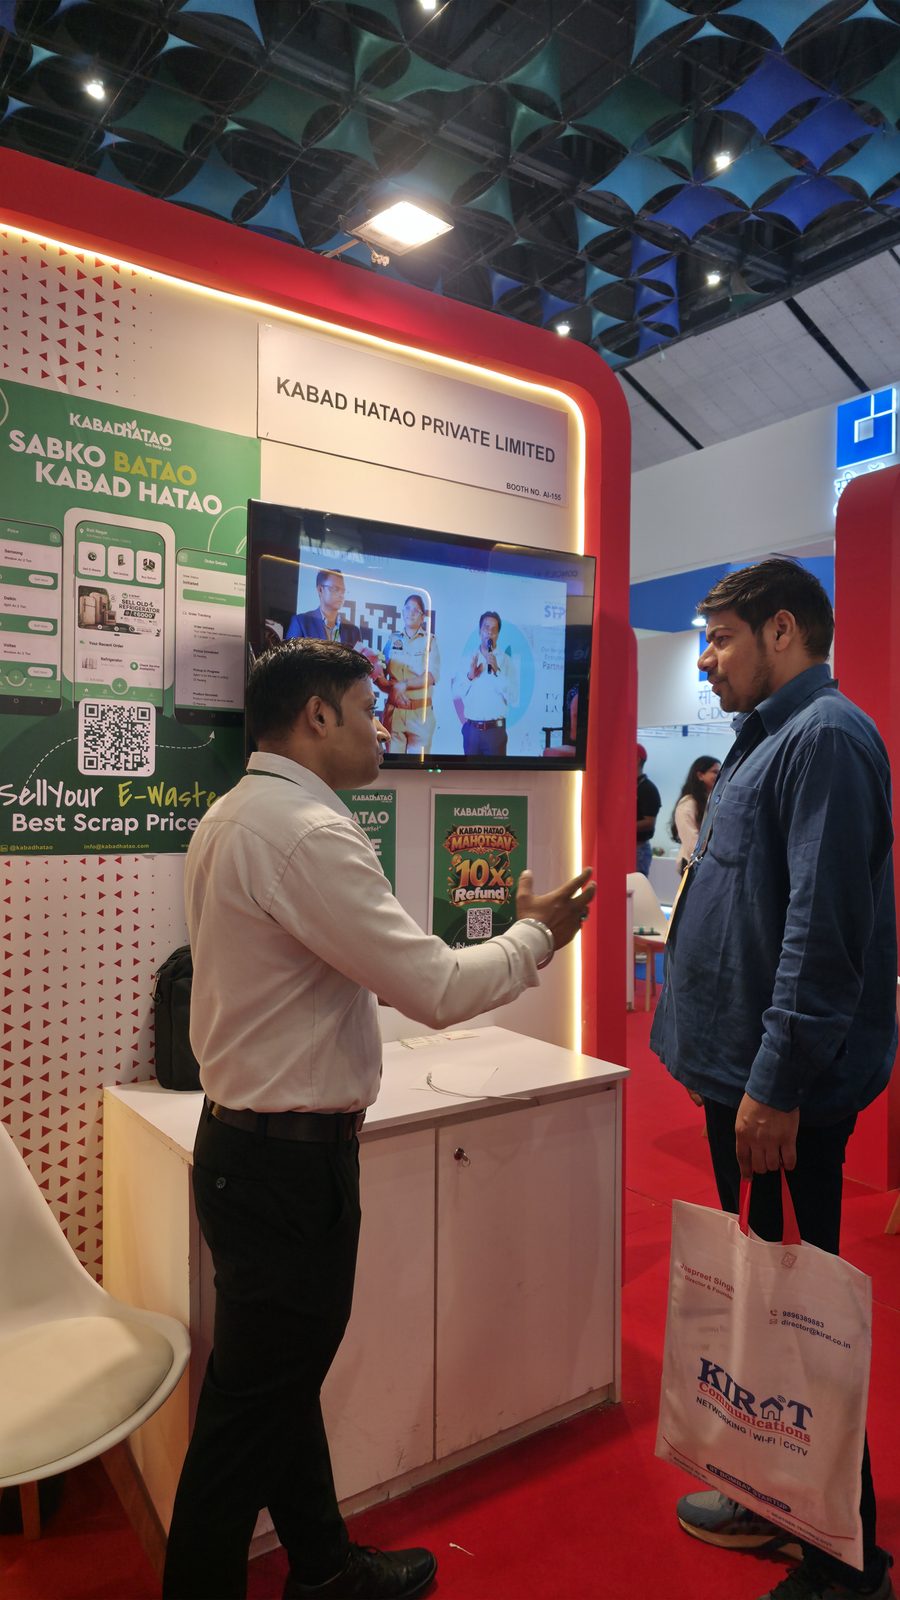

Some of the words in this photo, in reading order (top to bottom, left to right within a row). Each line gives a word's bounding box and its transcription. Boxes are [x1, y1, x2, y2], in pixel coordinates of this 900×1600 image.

[276, 376, 348, 411] KABAD
[354, 397, 416, 428] HATAO
[422, 414, 490, 448] PRIVATE
[495, 434, 556, 464] LIMITED
[9, 430, 106, 468] SABKO
[114, 450, 198, 486] BATAO
[36, 461, 131, 498] KABAD
[138, 481, 223, 515] HATAO
[506, 482, 529, 494] BOOTH
[530, 486, 541, 496] NO.
[118, 604, 160, 614] REFRIGERATOR
[118, 780, 221, 808] E-Waste
[12, 813, 66, 832] Best
[74, 814, 139, 836] Scrap
[451, 836, 512, 850] MAHOTSAV
[456, 858, 506, 888] 10x
[454, 887, 505, 902] Refund
[680, 1263, 712, 1282] Jaspreet
[713, 1277, 735, 1294] Singh
[782, 1310, 824, 1328] 9896389883
[696, 1396, 746, 1434] NETWORKING
[753, 1432, 776, 1445] WI-FI
[783, 1440, 808, 1457] CCTV
[699, 1382, 811, 1443] Communications
[752, 1490, 788, 1510] STARTUP
